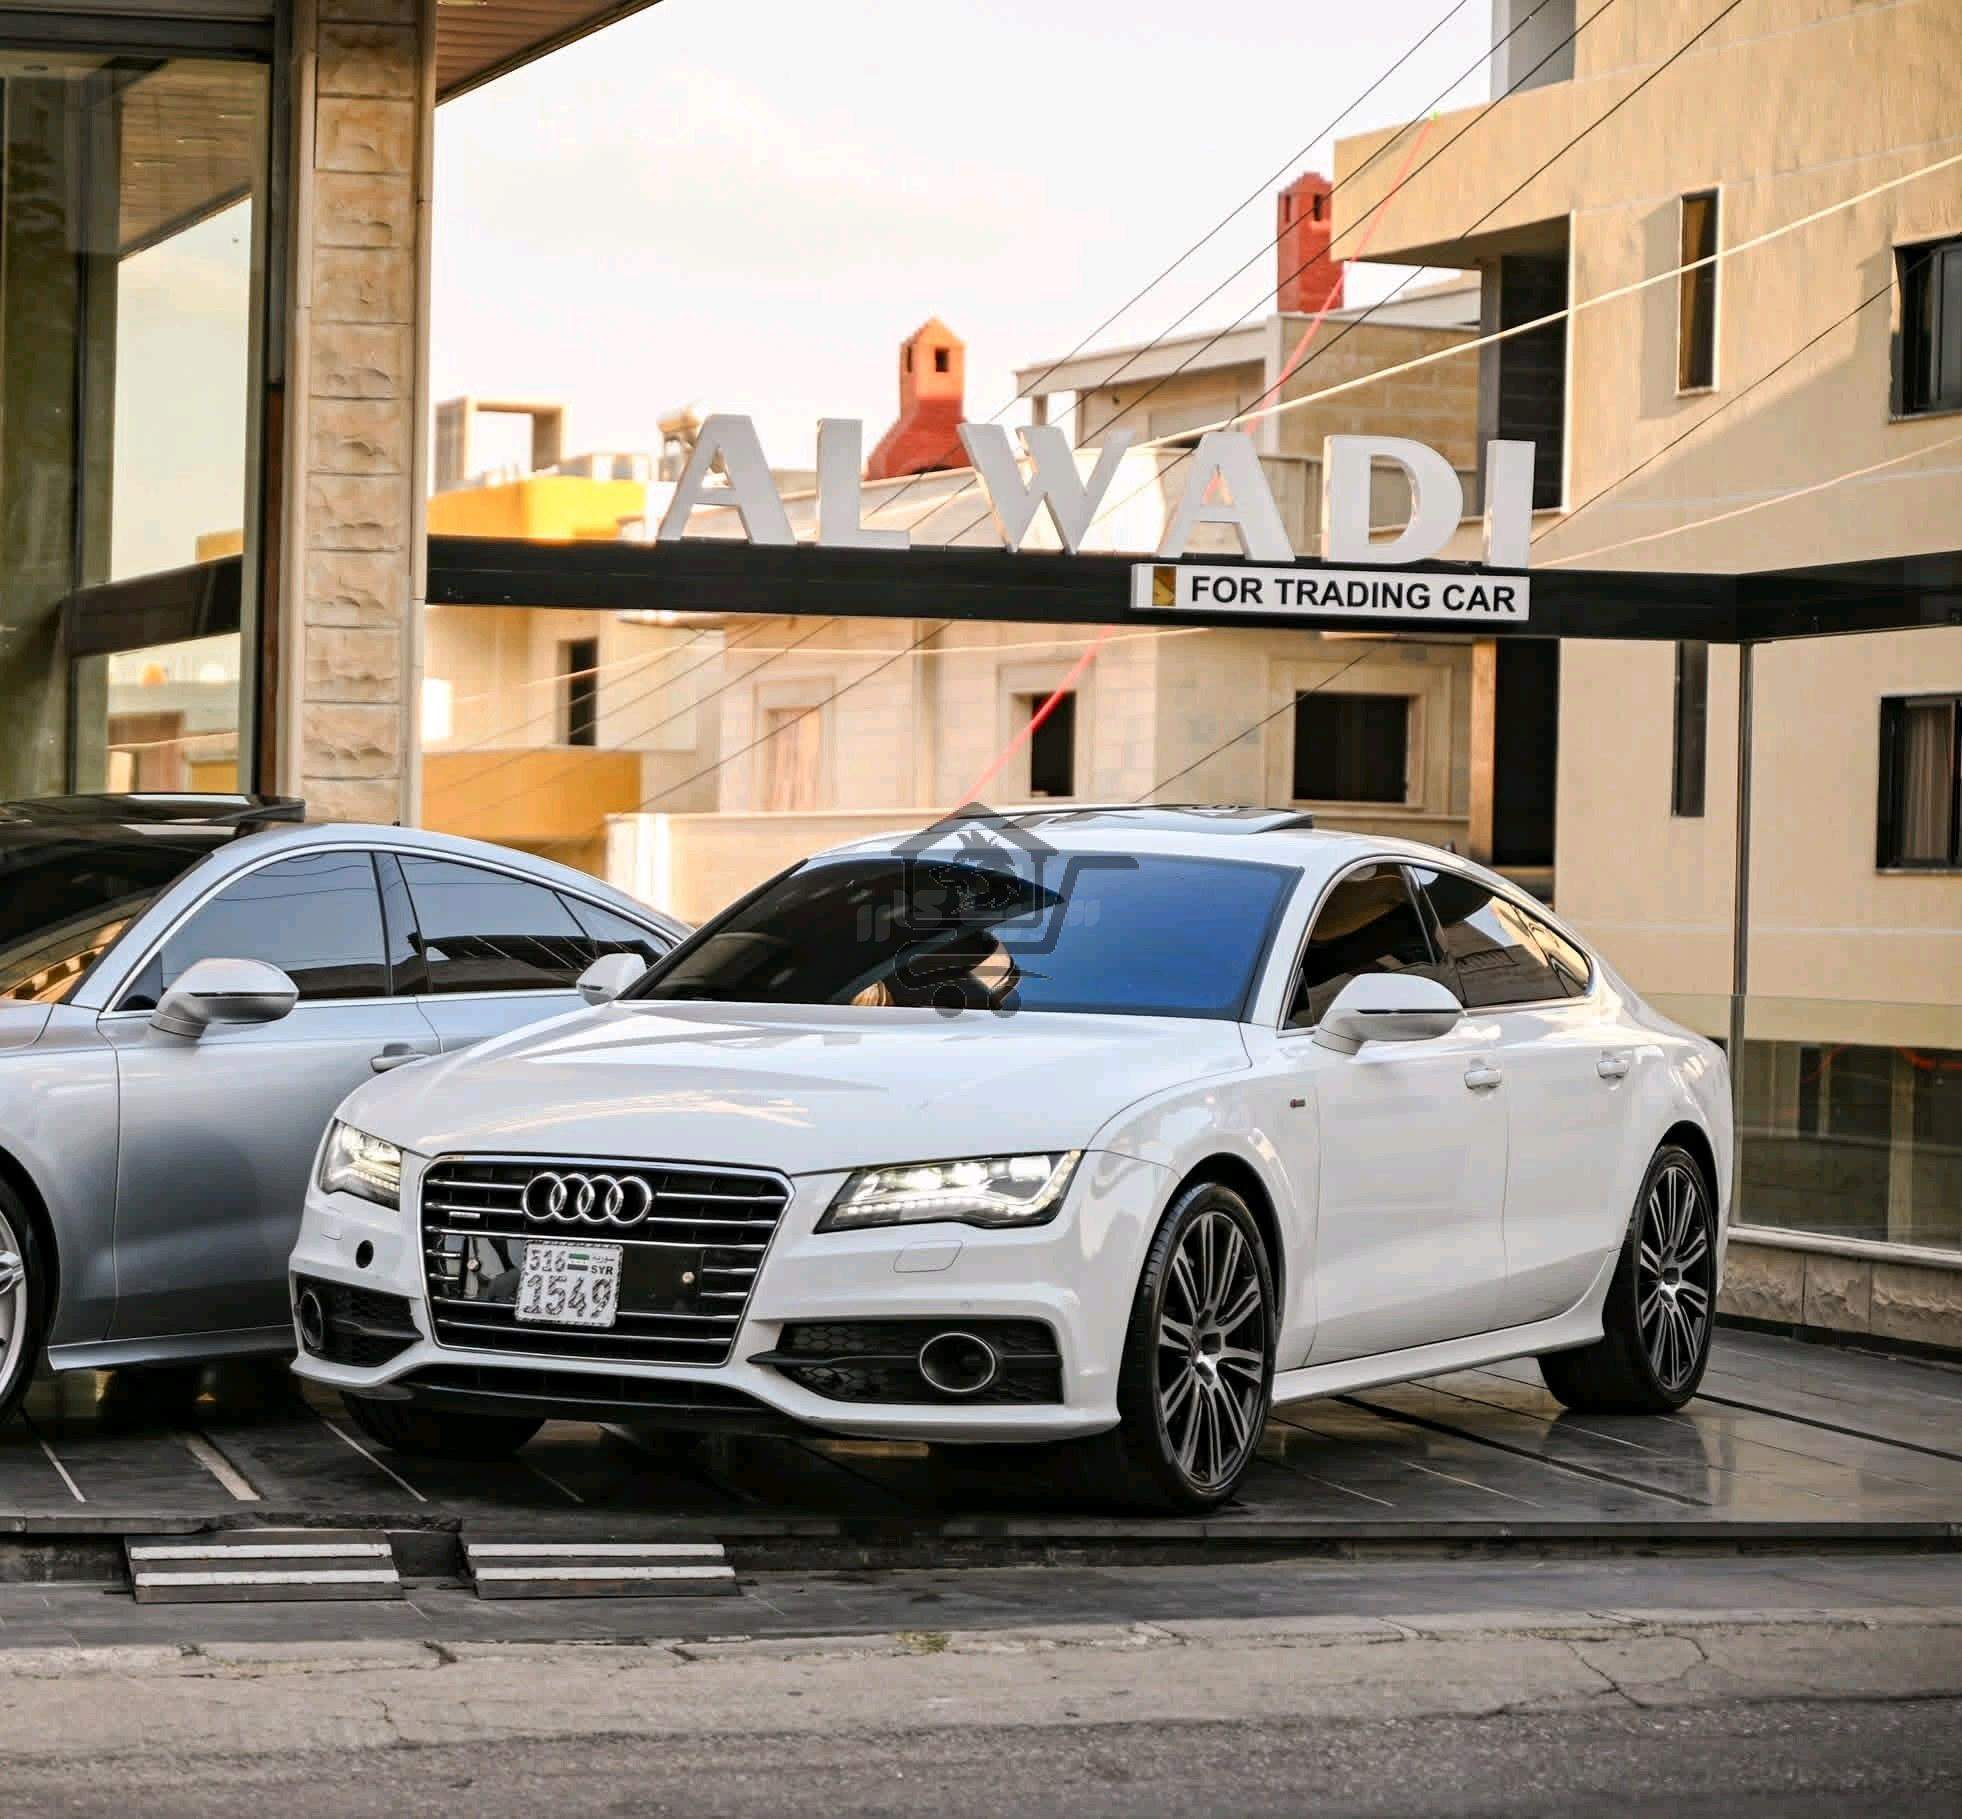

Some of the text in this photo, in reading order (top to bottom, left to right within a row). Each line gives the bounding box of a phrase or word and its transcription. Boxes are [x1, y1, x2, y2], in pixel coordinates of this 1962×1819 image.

[1191, 575, 1516, 613] FOR TRADING CAR
[591, 1265, 614, 1275] SYR
[522, 1274, 612, 1318] 1549
